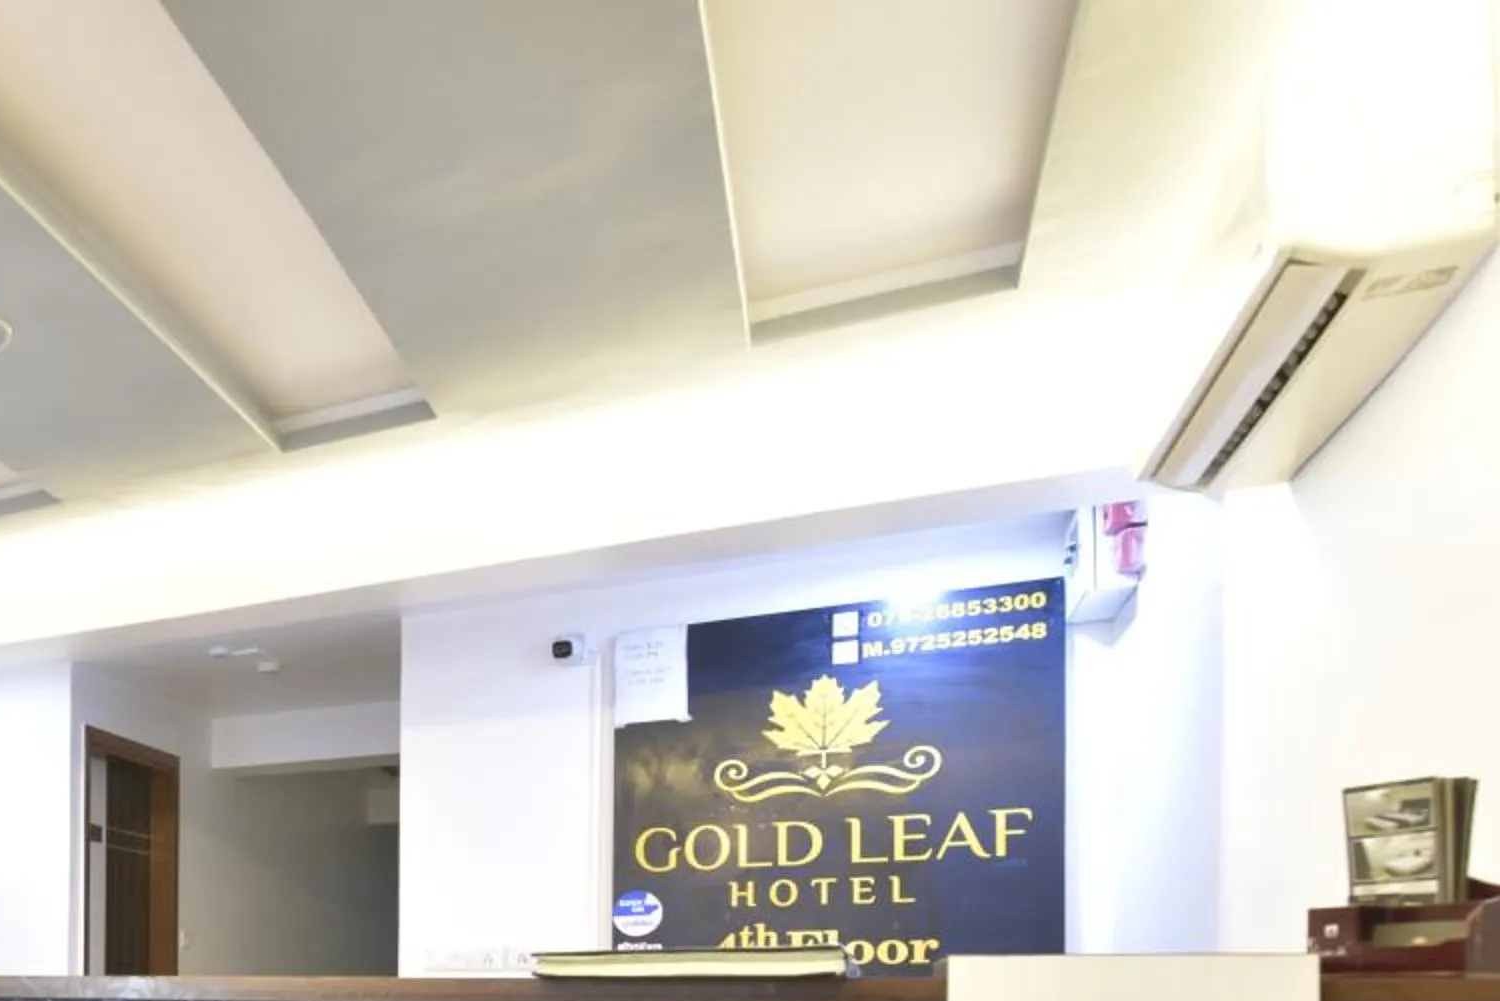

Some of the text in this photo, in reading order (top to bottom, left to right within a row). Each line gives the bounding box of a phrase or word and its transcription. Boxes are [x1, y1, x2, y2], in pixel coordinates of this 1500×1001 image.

[867, 591, 1047, 628] 07-26853300
[861, 621, 1047, 659] M.9725252548
[634, 807, 1033, 873] GOLD LEAF
[729, 875, 917, 908] HOTEL
